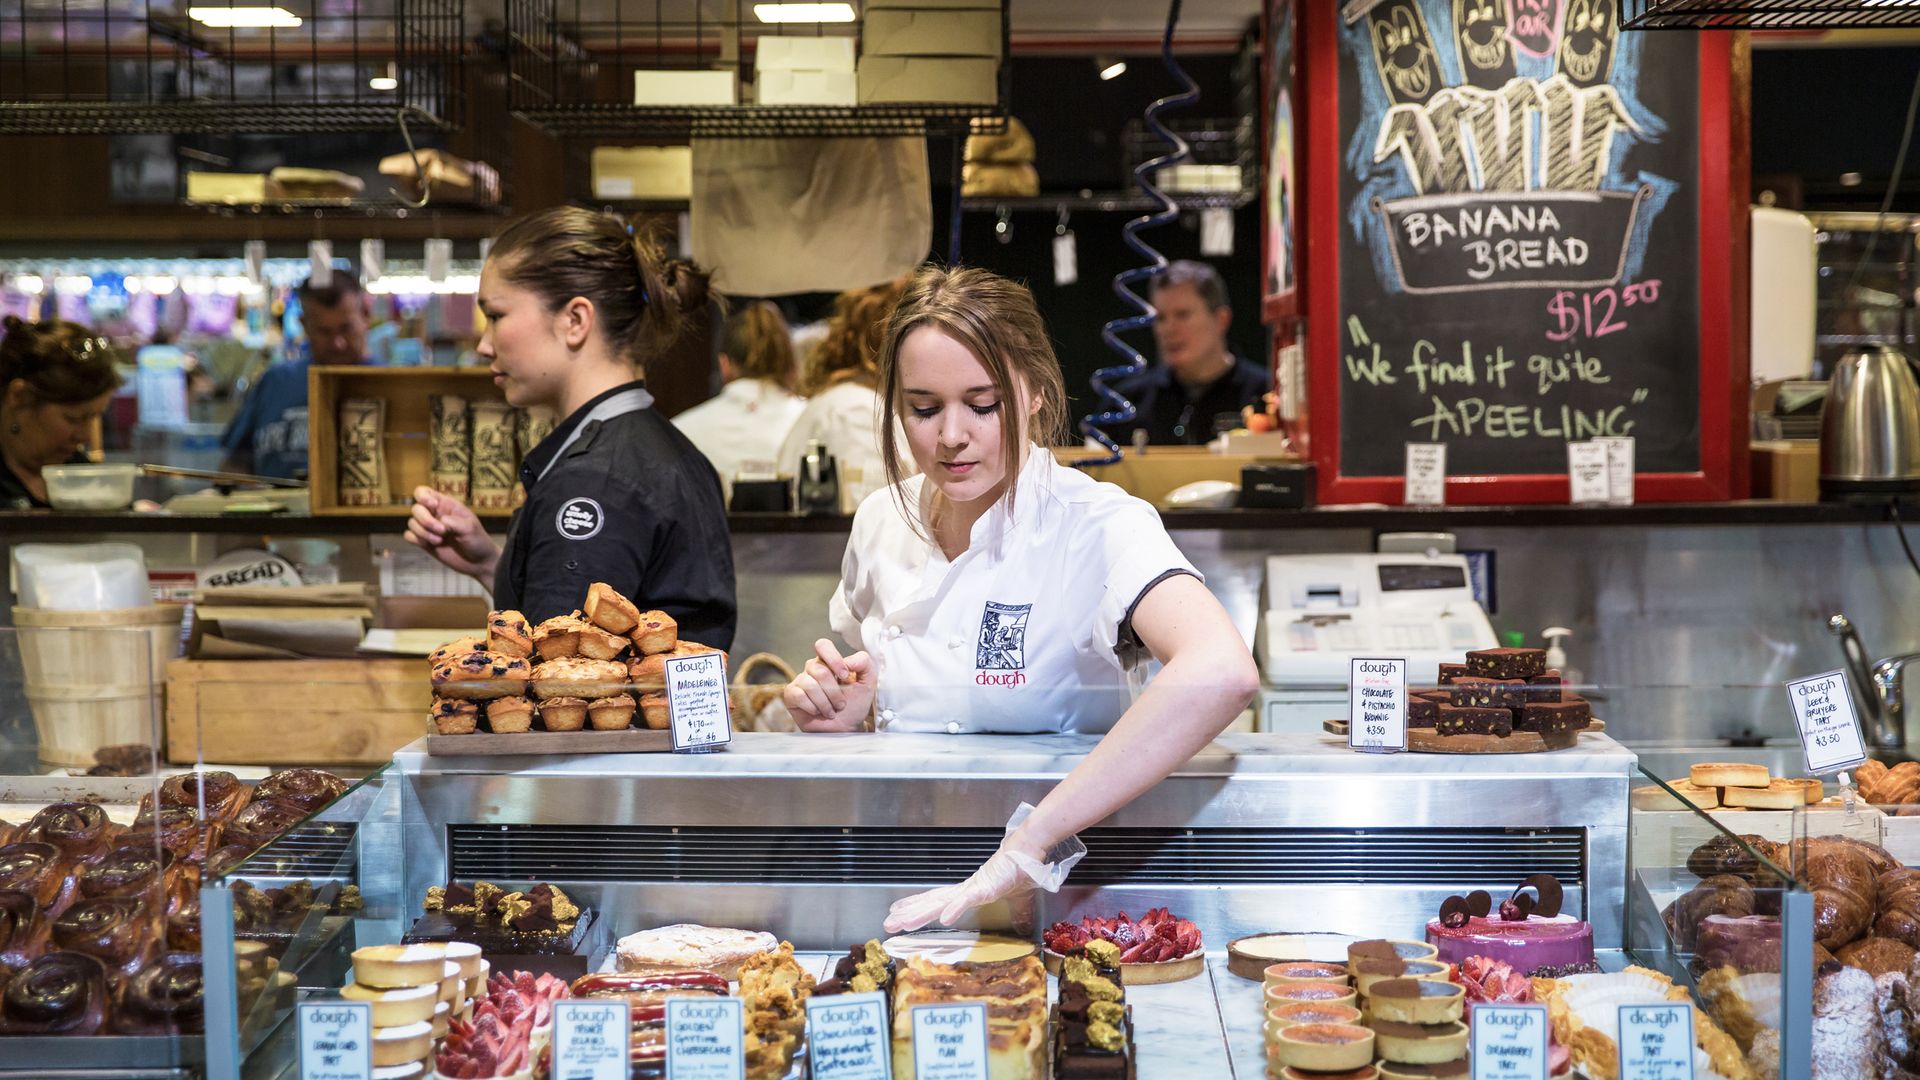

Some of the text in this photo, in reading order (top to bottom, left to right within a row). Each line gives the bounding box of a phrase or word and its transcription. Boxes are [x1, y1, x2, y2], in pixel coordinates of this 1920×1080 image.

[1402, 205, 1560, 247] BANANA
[1463, 237, 1589, 279] BREAD
[1405, 339, 1476, 393] find
[1486, 346, 1515, 388] it
[1528, 350, 1611, 395] quite
[206, 560, 284, 587] BREAD
[675, 659, 713, 673] dough
[1359, 662, 1397, 676] dough
[975, 670, 1026, 690] dough
[1798, 679, 1836, 696] dough
[1361, 687, 1394, 699] CHOCOLATE
[1367, 701, 1396, 711] PISTACHIO
[1807, 696, 1823, 708] LEEK
[1364, 712, 1389, 722] BROWNIE
[1806, 704, 1837, 718] GRUYERE
[309, 1009, 358, 1029] dough
[566, 1007, 616, 1026] dough
[679, 1003, 729, 1021] dough
[820, 1006, 870, 1026] dough
[923, 1009, 973, 1029] dough
[1485, 1010, 1534, 1030] dough
[1629, 1009, 1679, 1028] dough
[674, 1021, 714, 1032] GOLDEN
[814, 1026, 877, 1041] Chocolate
[674, 1034, 719, 1044] GAYTIME
[675, 1046, 732, 1056] CHEESECAKE
